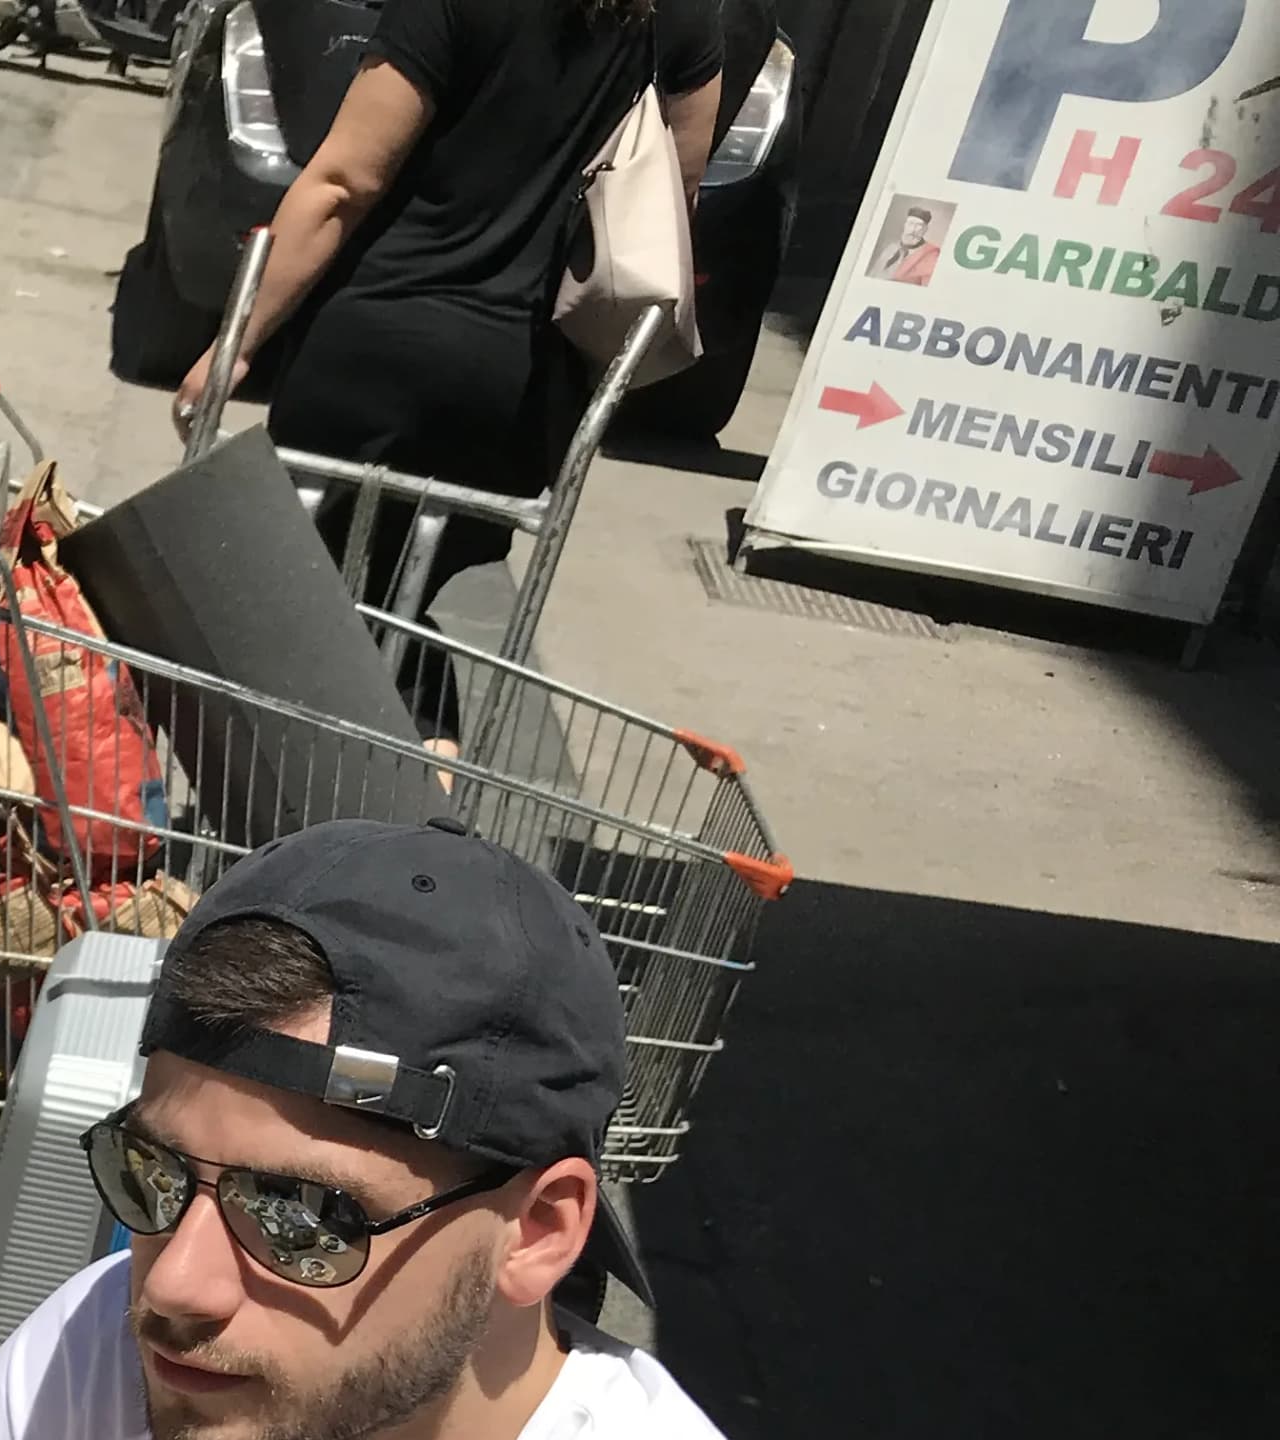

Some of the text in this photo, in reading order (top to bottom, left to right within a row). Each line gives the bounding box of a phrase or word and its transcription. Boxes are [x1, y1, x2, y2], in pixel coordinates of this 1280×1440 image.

[948, 0, 1246, 191] P
[1053, 128, 1143, 206] H
[843, 305, 1280, 420] ABBONAMENTI
[906, 397, 1152, 480] MENSILI
[815, 460, 1196, 571] GIORNALIERI
